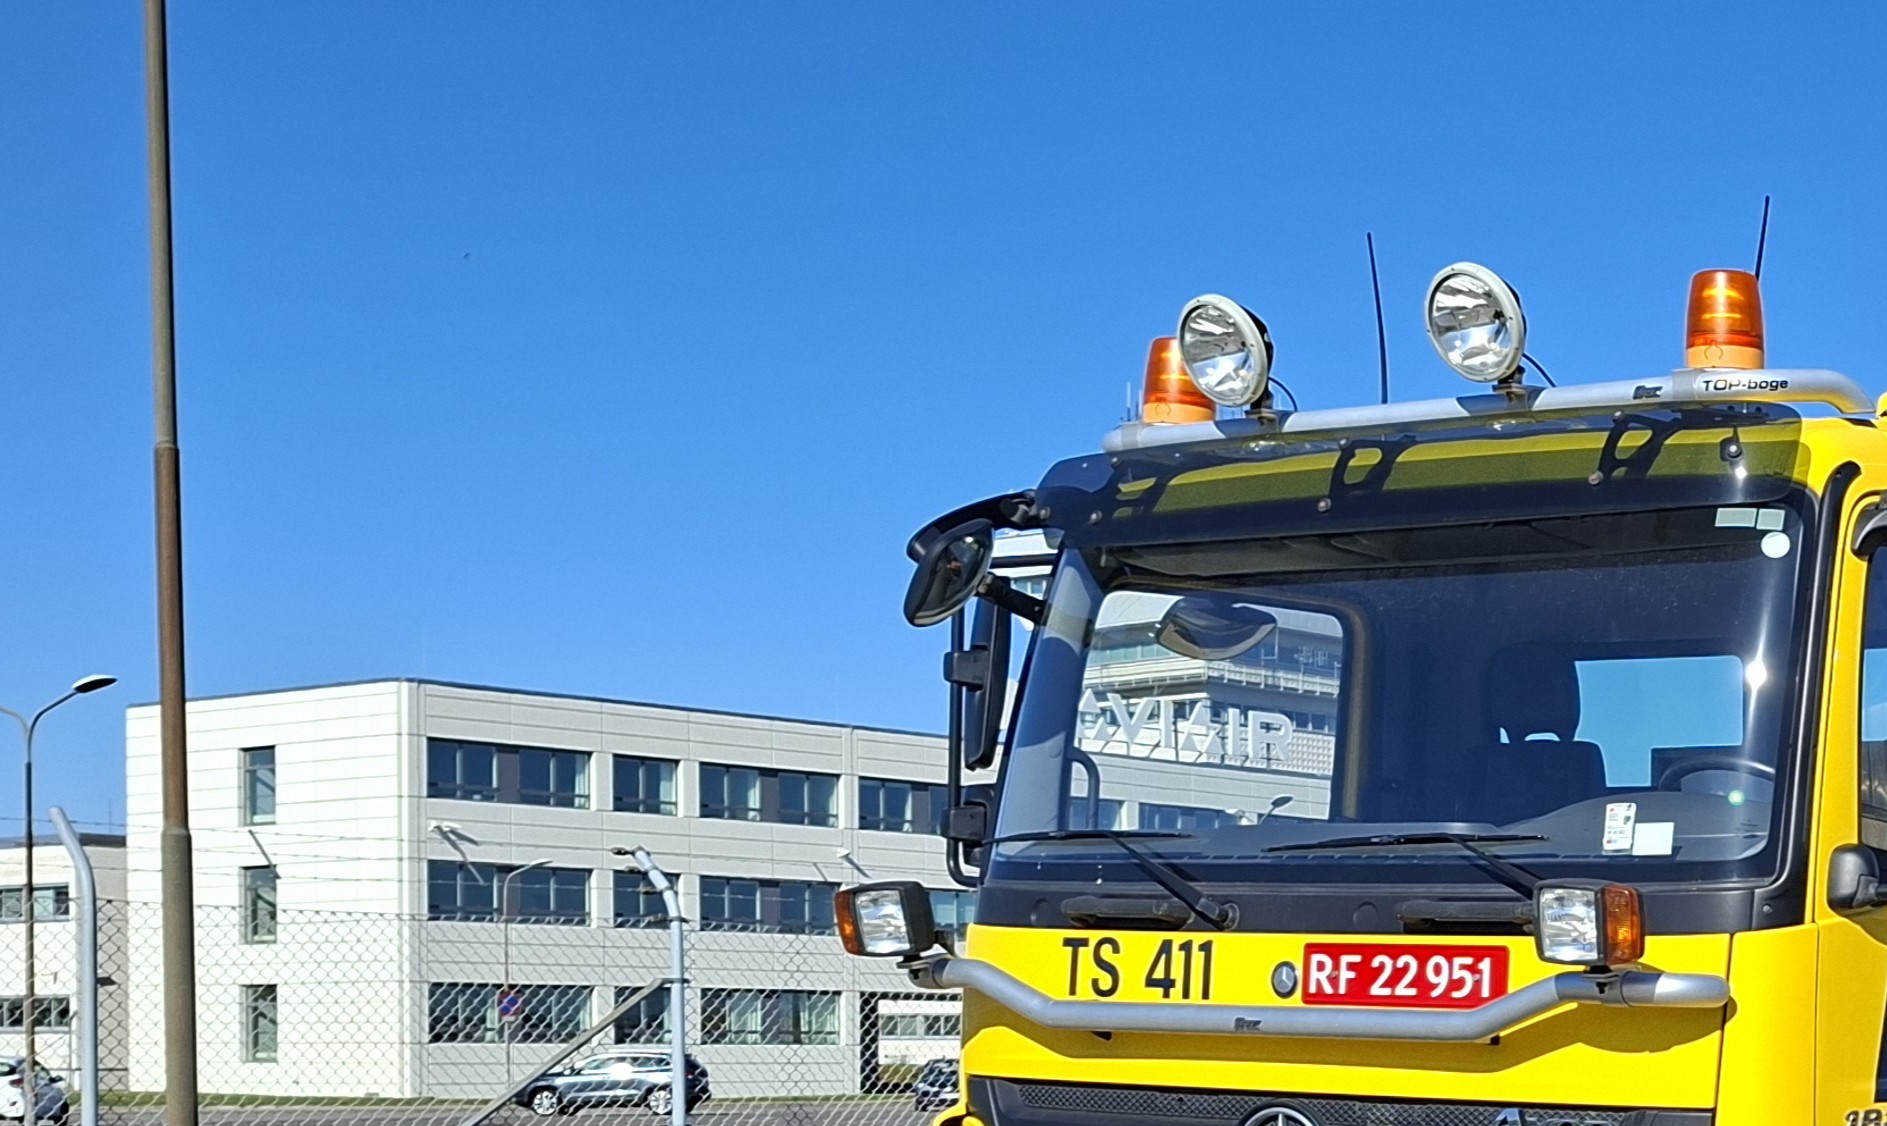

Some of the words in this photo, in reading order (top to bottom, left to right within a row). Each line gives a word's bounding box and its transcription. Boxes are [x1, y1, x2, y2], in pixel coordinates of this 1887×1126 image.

[1075, 688, 1294, 763] AVIAIR
[1062, 936, 1121, 998] TS
[1144, 938, 1214, 1001] 411
[1307, 953, 1363, 995] RF
[1369, 954, 1418, 997] 22
[1425, 954, 1492, 999] 951
